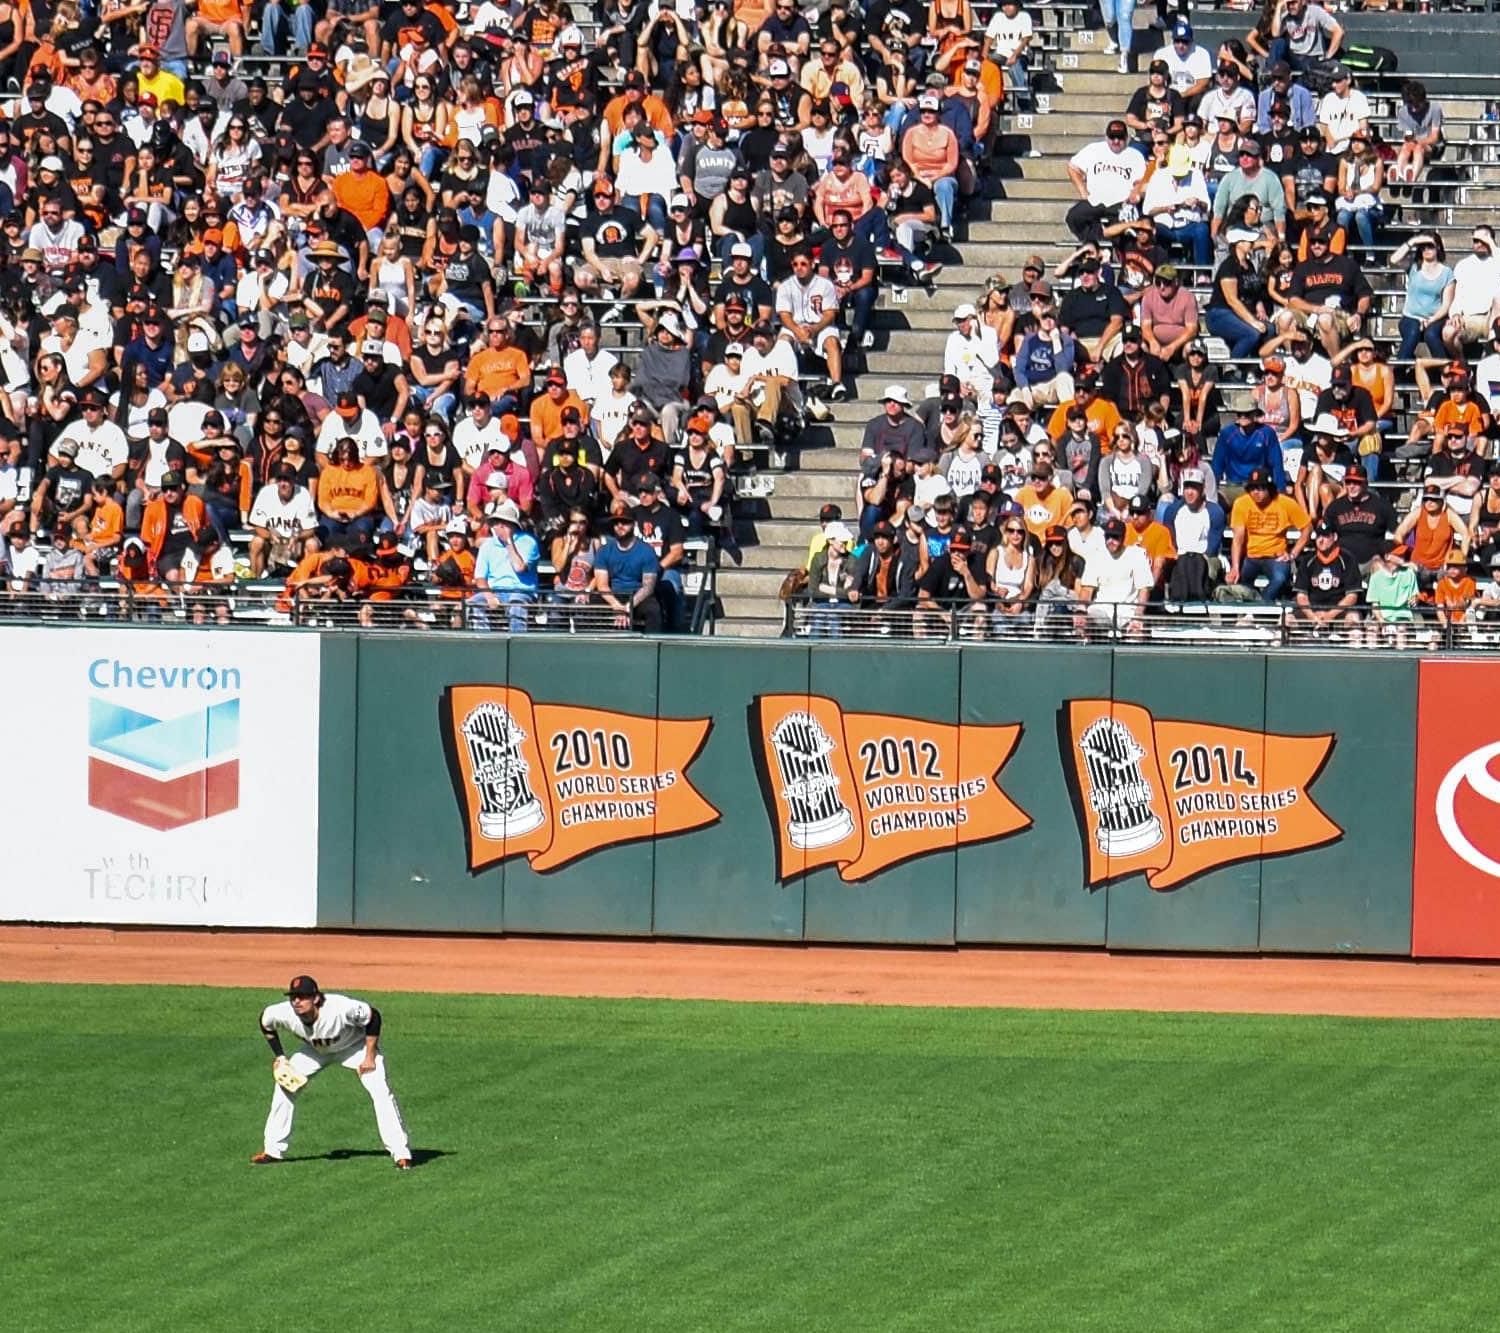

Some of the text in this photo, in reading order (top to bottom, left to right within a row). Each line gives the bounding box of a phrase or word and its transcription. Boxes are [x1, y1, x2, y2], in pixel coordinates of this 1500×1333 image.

[1092, 161, 1133, 180] GIANTS
[1306, 275, 1343, 287] GIANTS
[78, 441, 109, 458] ANTS
[1337, 512, 1377, 524] GIANTS
[88, 658, 241, 690] Chevron
[551, 729, 631, 774] 2010
[860, 738, 943, 782] 2012
[1171, 746, 1256, 790] 2014
[557, 771, 676, 799] WORLD SERIES
[866, 786, 925, 810] WORLD
[930, 778, 986, 803] SERIES
[561, 800, 657, 827] CHAMPIONS
[1176, 788, 1298, 817] WORLD SERIES
[870, 808, 968, 837] CHAMPIONS
[1180, 817, 1278, 845] CHAMPIONS
